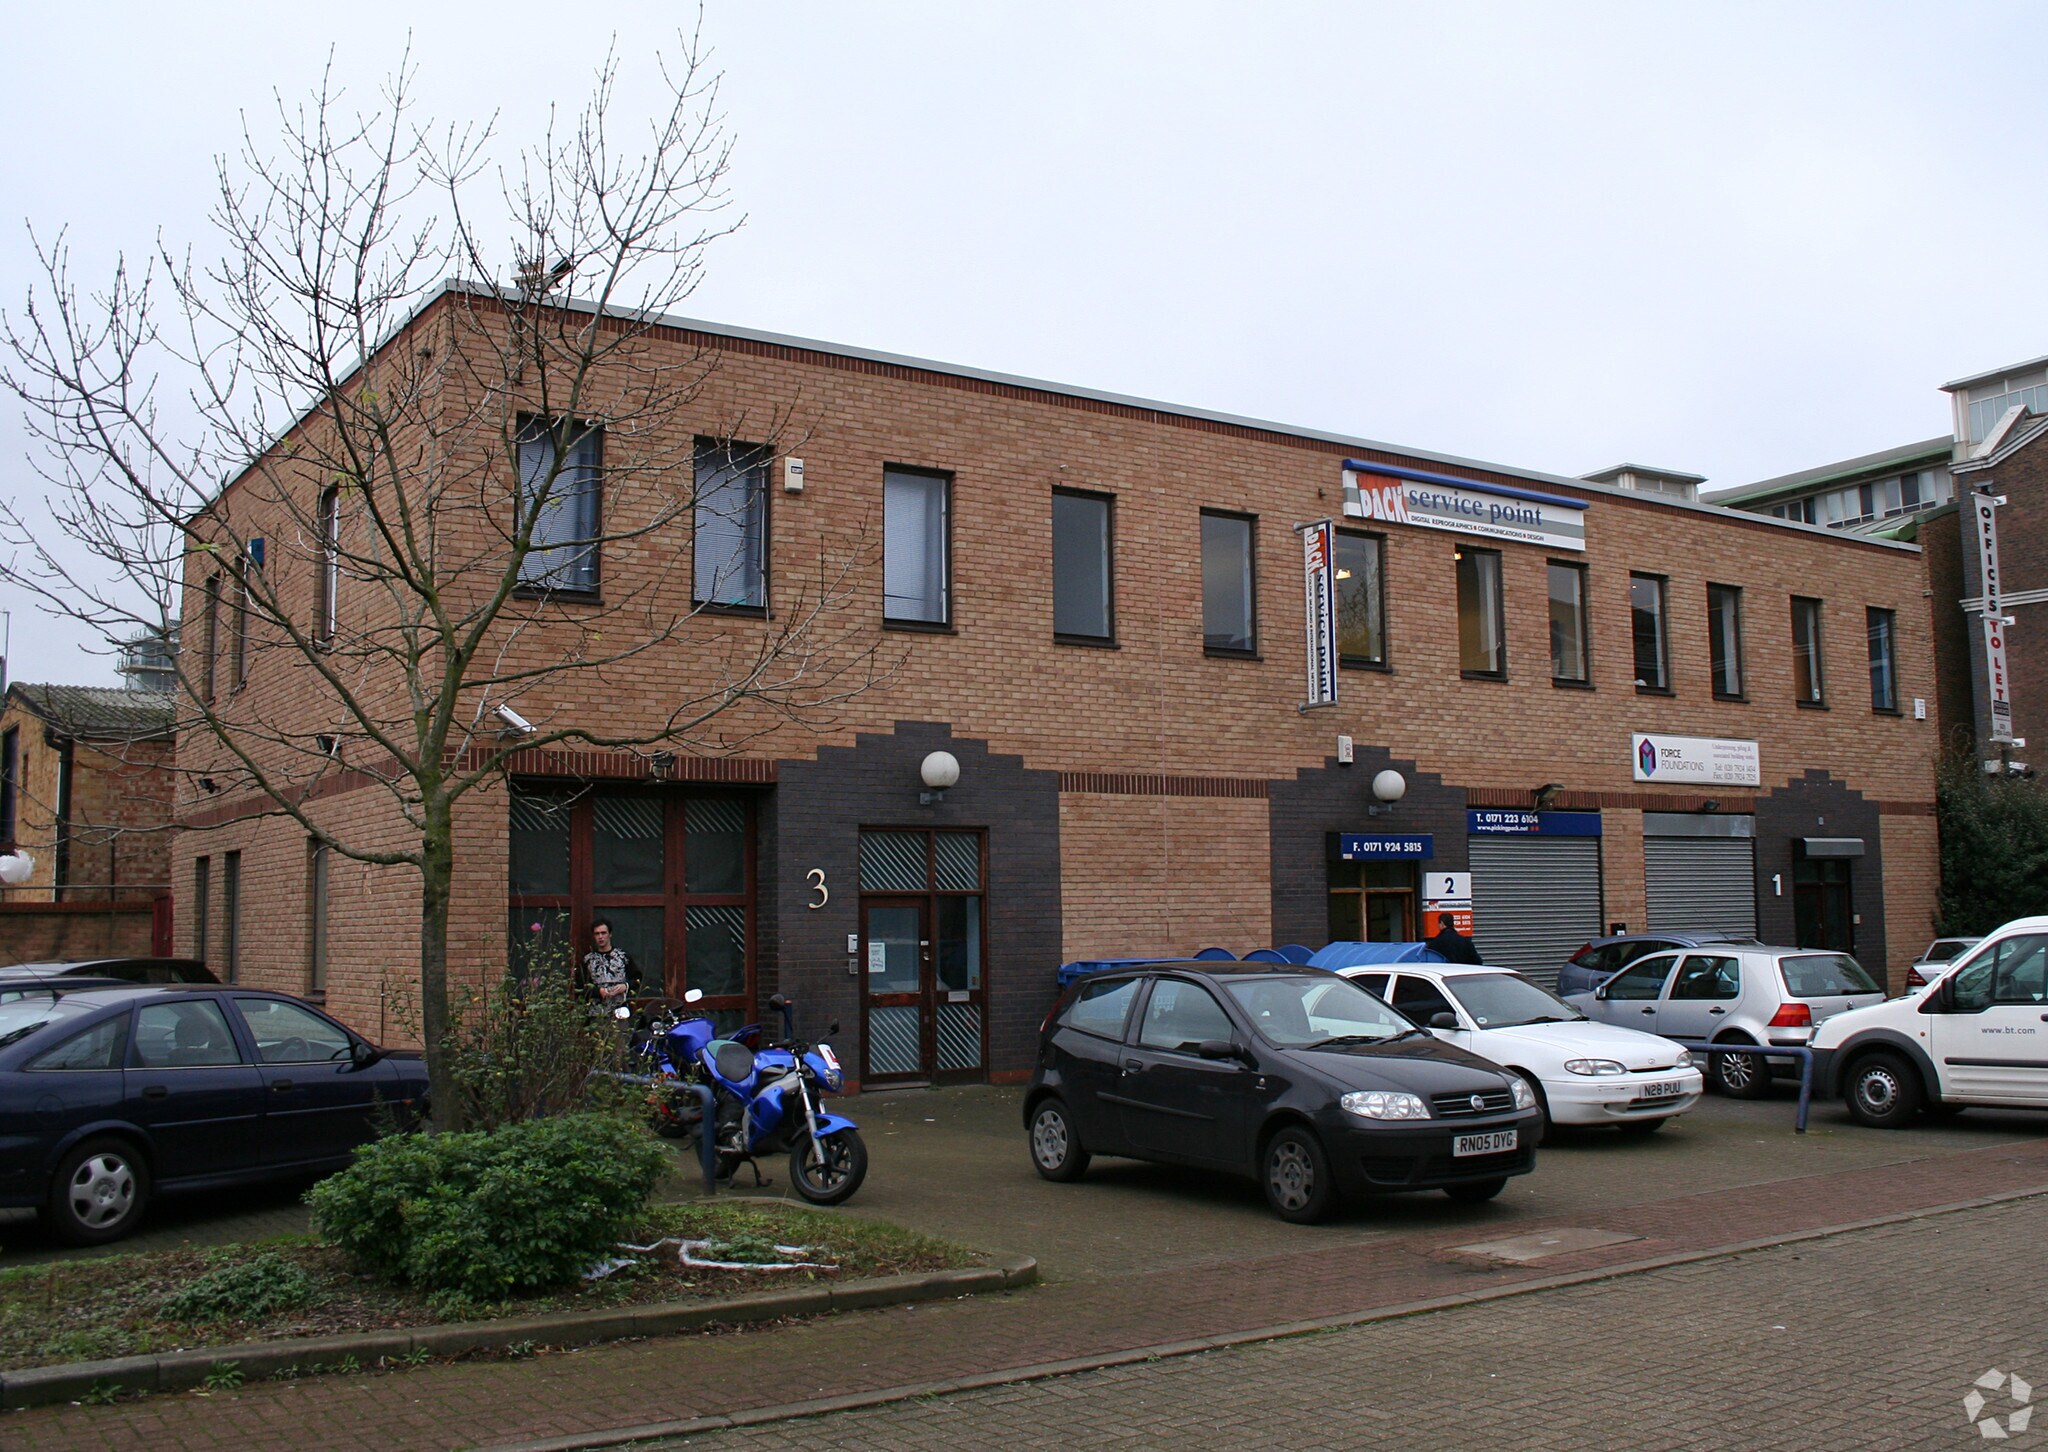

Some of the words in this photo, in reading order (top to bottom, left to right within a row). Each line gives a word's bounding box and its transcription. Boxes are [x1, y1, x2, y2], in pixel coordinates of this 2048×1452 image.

[1360, 486, 1409, 523] PACK
[1409, 489, 1483, 517] service
[1489, 501, 1542, 526] point
[1411, 515, 1431, 524] DIGITAL
[1432, 519, 1473, 531] REPROGRAPHICS
[1478, 525, 1523, 539] COMMUNICATIONS
[1527, 533, 1545, 541] DESIGN
[1980, 506, 1998, 613] OFFICES
[1317, 574, 1328, 640] service
[1989, 620, 2001, 650] TO
[1317, 646, 1330, 695] point
[1993, 656, 2005, 701] LET
[1661, 748, 1681, 758] FORCE
[1661, 760, 1704, 771] FOUNDATIONS
[1476, 813, 1483, 822] T.
[1486, 813, 1501, 823] 0171
[1504, 814, 1519, 823] 223
[1521, 814, 1538, 823] 6104
[1353, 842, 1360, 852] F.
[1363, 842, 1381, 852] 0171
[1384, 842, 1400, 852] 924
[1404, 842, 1422, 852] 5815
[806, 868, 829, 909] 3
[1444, 876, 1454, 893] 2
[1772, 874, 1782, 896] 1
[1981, 1026, 2035, 1034] www.bt.com
[1644, 1084, 1663, 1096] N28
[1664, 1081, 1680, 1094] PUU
[1460, 1135, 1490, 1152] RN05
[1493, 1132, 1513, 1149] DYG
